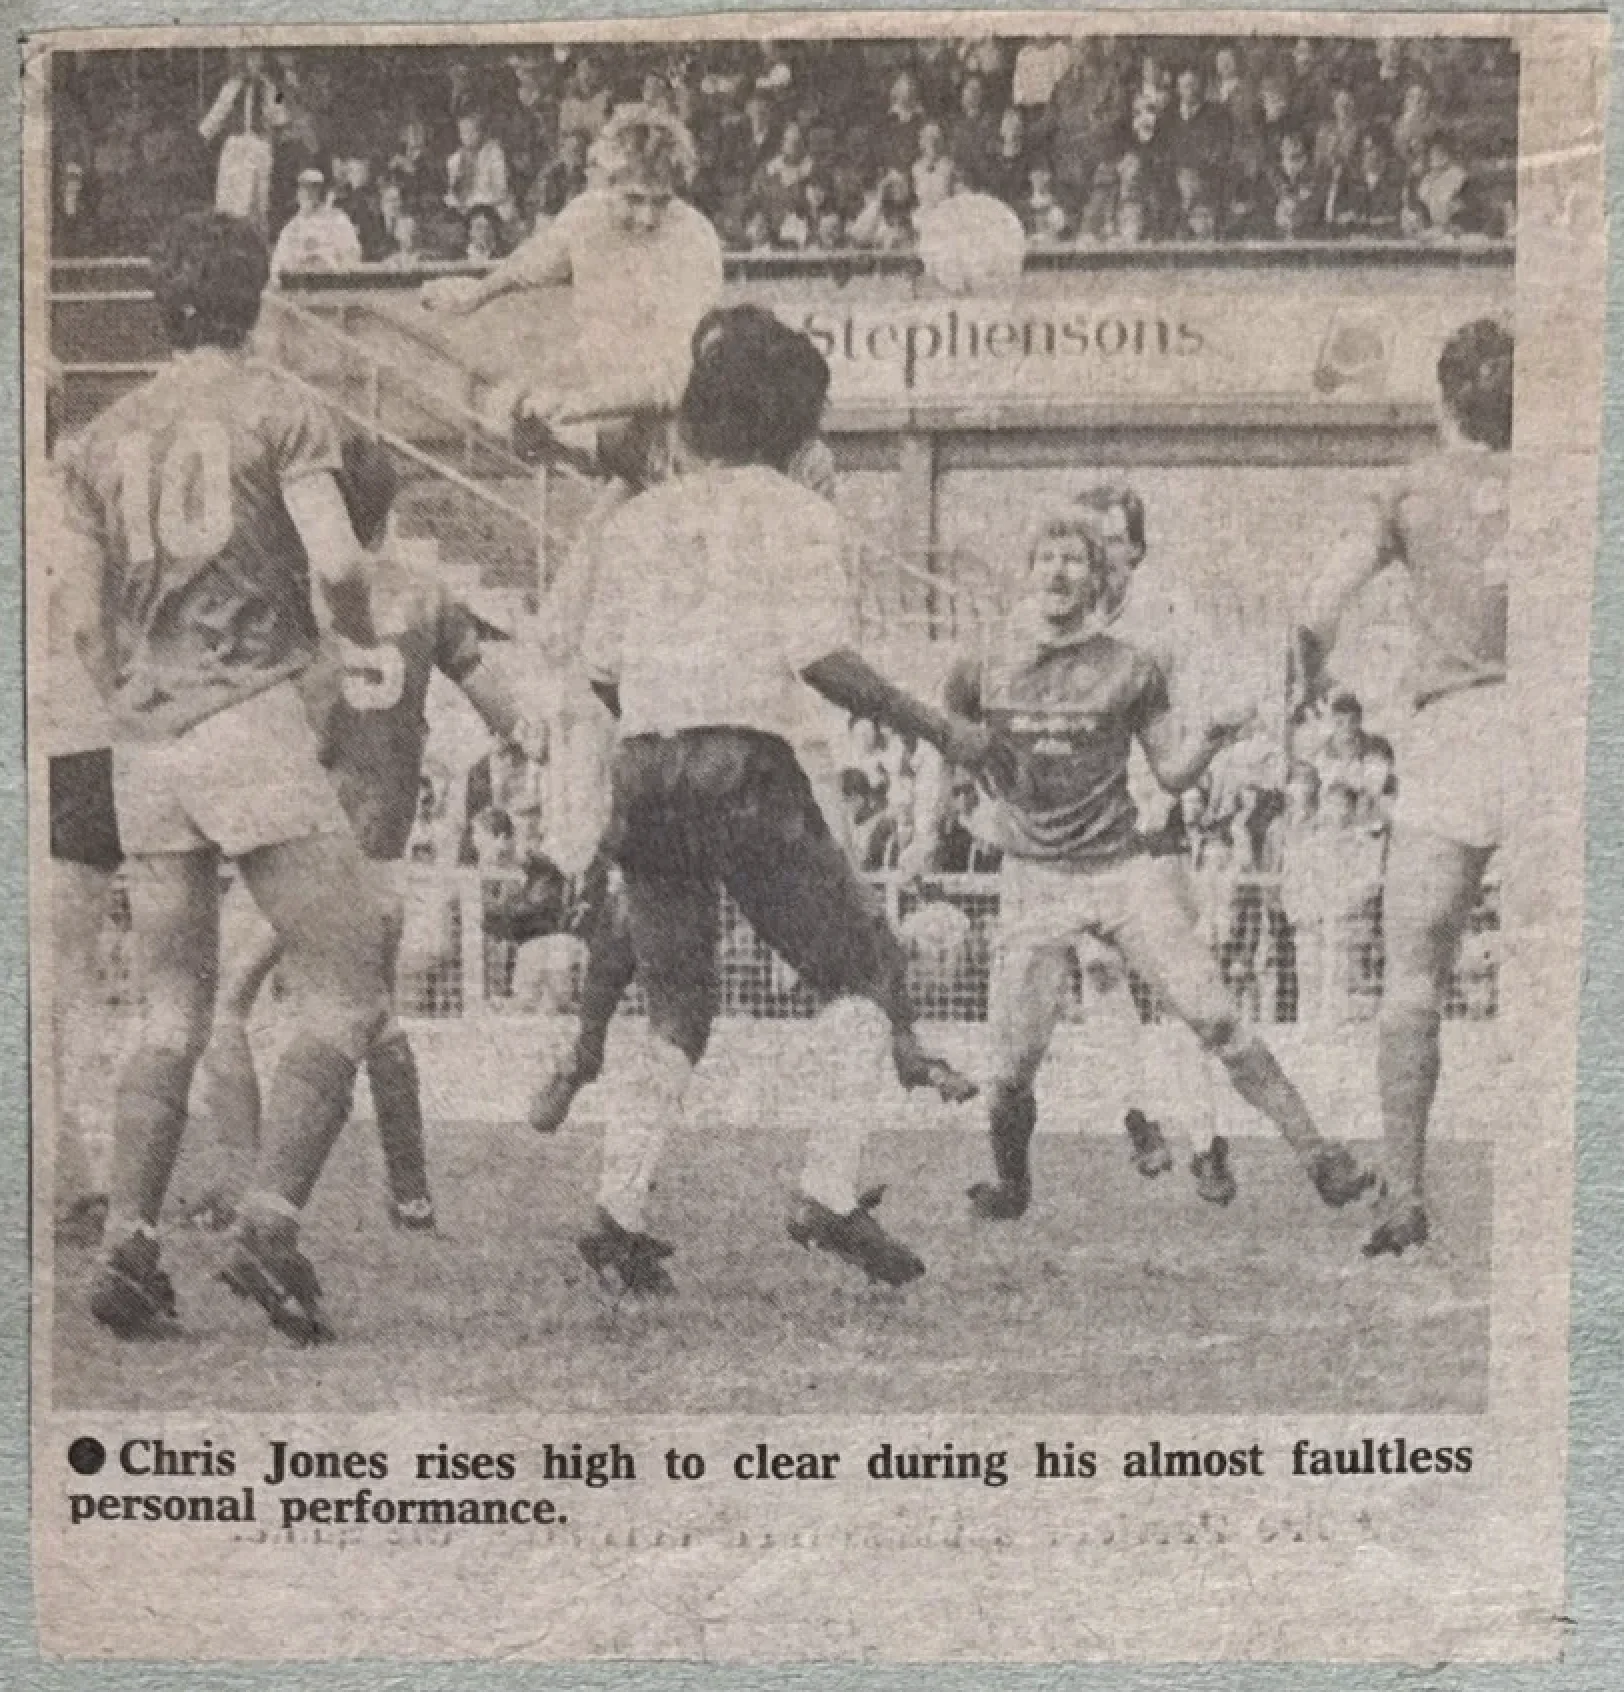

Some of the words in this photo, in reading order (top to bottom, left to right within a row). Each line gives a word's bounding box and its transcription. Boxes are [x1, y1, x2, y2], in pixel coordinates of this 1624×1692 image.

[803, 308, 1207, 389] Stephensons
[115, 418, 234, 562] 10
[119, 1438, 236, 1477] Chris
[263, 1441, 388, 1485] Jones
[415, 1443, 516, 1481] rises
[543, 1443, 638, 1489] high
[665, 1447, 706, 1481] to
[733, 1443, 842, 1481] clear
[867, 1443, 1009, 1488] during
[1035, 1441, 1098, 1479] his
[1123, 1441, 1265, 1478] almost
[1292, 1437, 1474, 1476] faultless
[67, 1487, 256, 1526] personal
[279, 1489, 568, 1530] performance.
